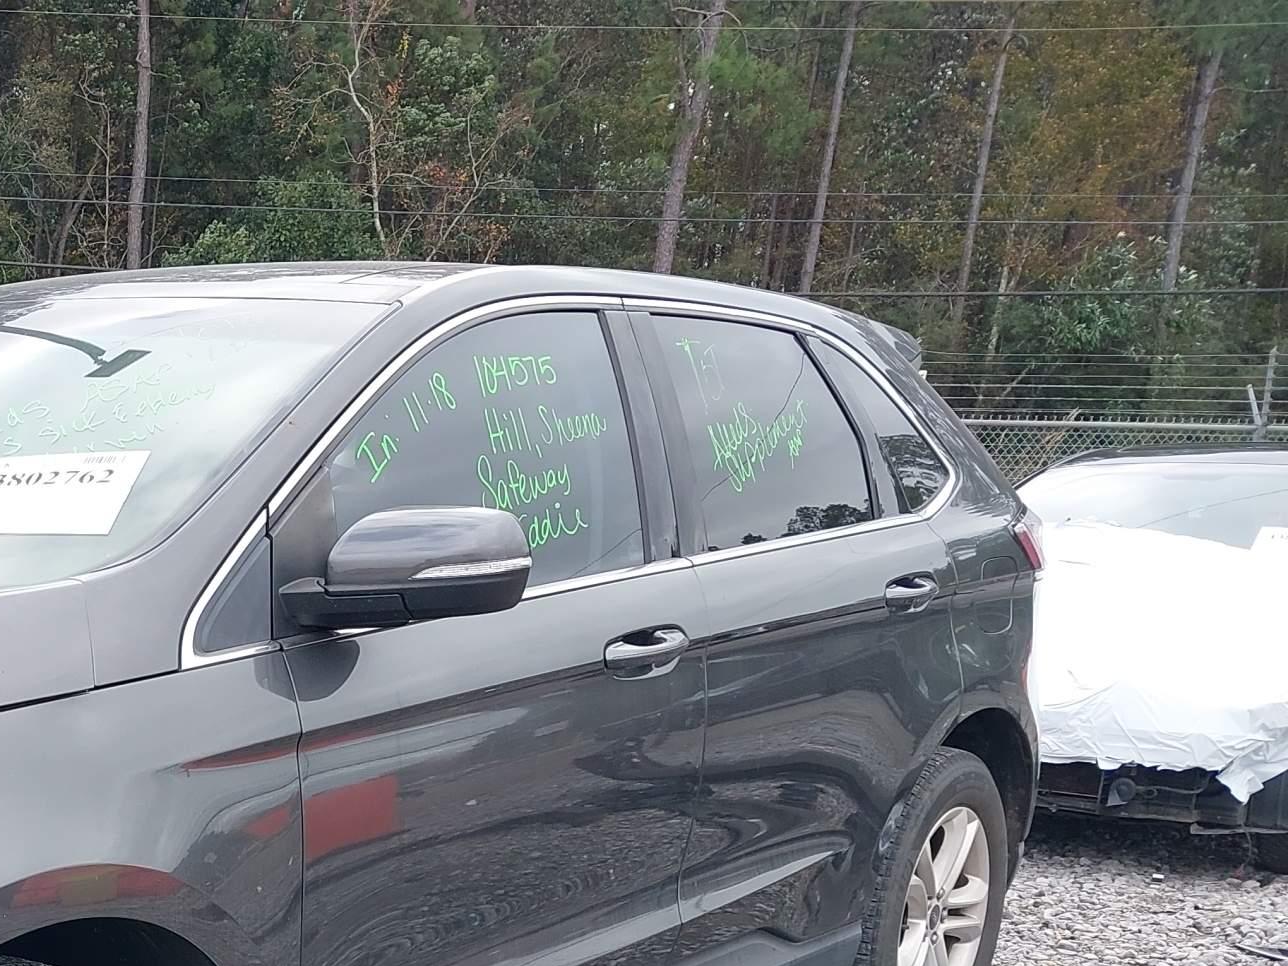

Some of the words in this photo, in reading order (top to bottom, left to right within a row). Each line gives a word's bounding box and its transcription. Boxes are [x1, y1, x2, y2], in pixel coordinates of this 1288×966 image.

[472, 355, 558, 399] 104575
[483, 406, 542, 459] Hill,
[537, 404, 608, 447] Sheena
[476, 454, 572, 511] Safeway
[518, 501, 589, 548] ddie
